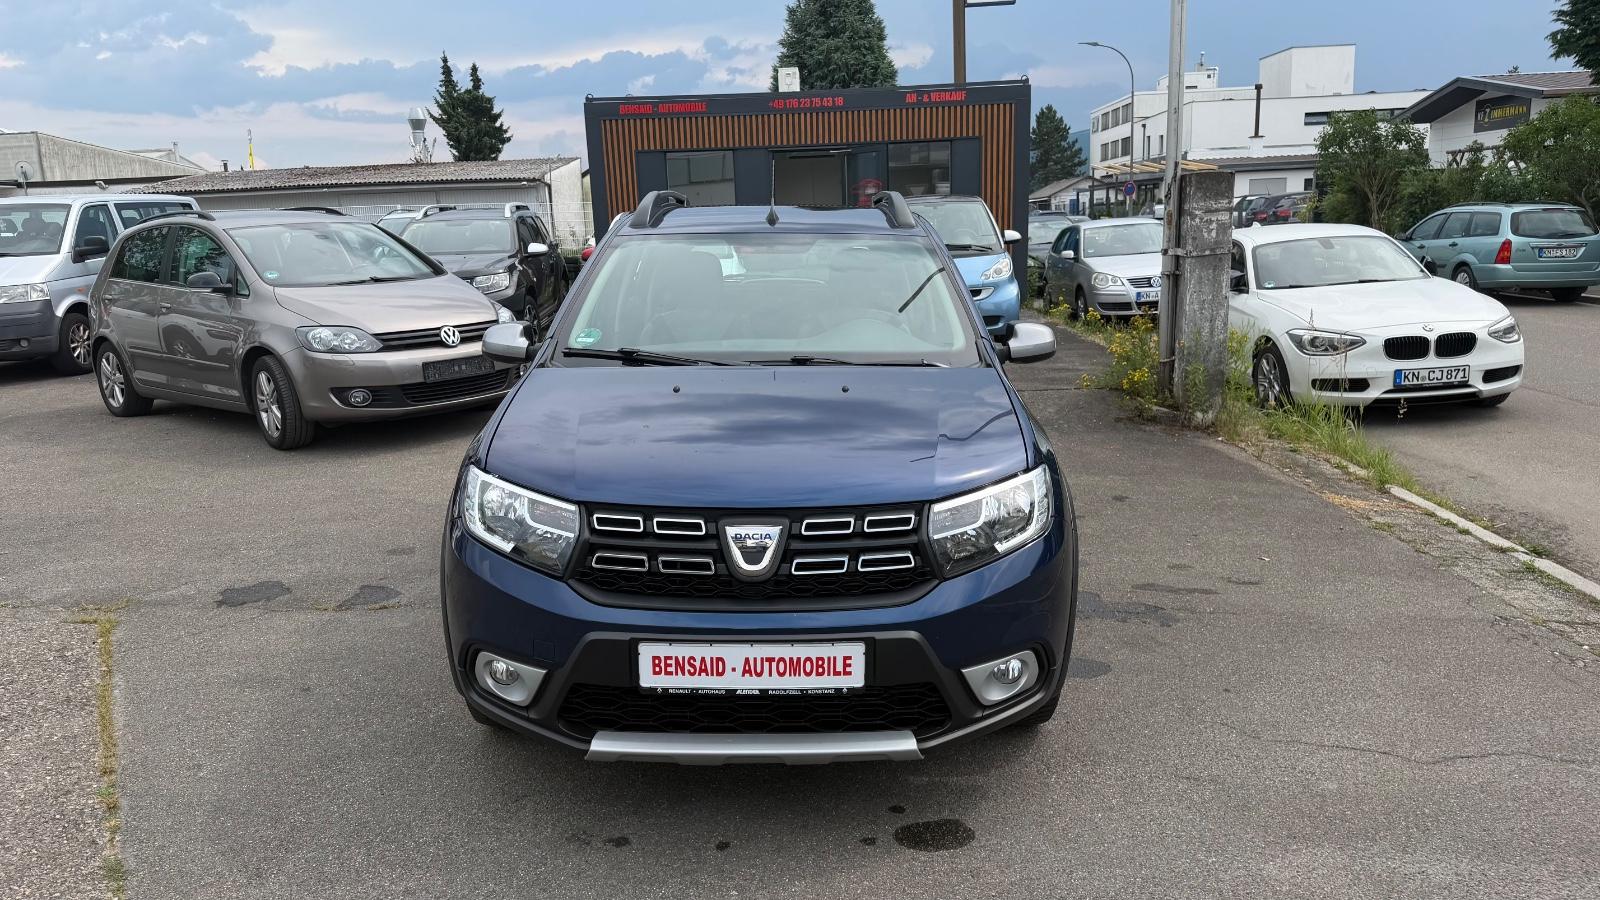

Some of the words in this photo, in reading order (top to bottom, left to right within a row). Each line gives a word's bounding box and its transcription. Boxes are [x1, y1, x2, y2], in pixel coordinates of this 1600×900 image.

[931, 90, 967, 102] VERKAUF
[620, 104, 653, 115] BENSAID
[658, 102, 707, 113] AUTOMOBILE
[786, 99, 799, 109] 176
[800, 98, 811, 108] 23
[812, 97, 821, 107] 75
[822, 97, 833, 107] 43
[1403, 371, 1420, 383] KN
[1427, 369, 1444, 382] CJ
[1445, 367, 1468, 380] 871
[651, 655, 726, 677] BENSAID
[741, 655, 853, 678] AUTOMOBILE
